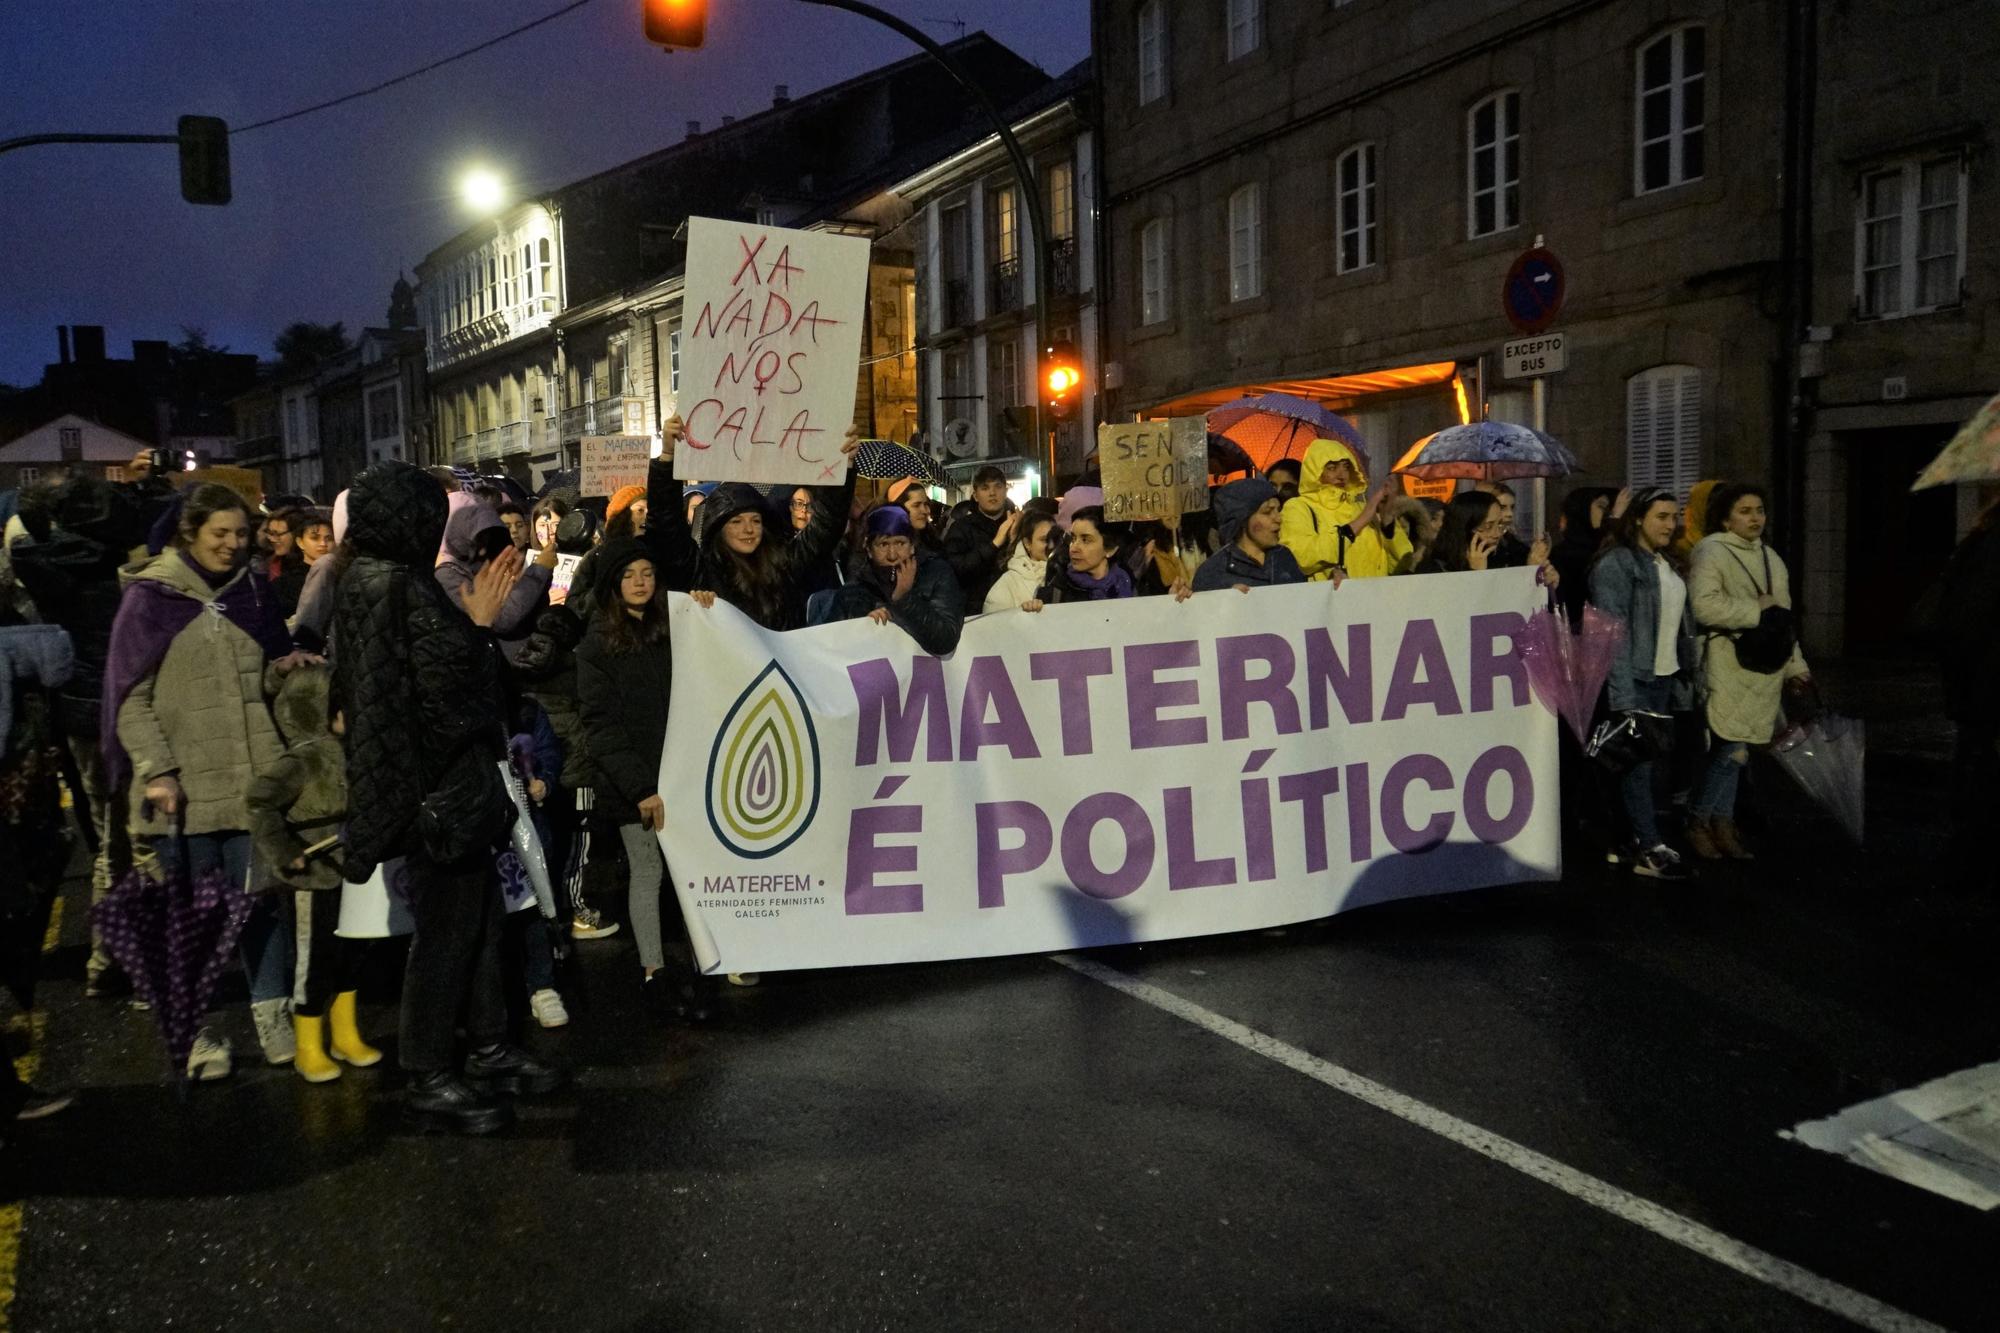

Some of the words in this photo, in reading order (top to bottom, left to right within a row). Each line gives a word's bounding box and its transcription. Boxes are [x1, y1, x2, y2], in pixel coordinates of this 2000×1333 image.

[732, 234, 806, 292] XA
[692, 288, 847, 351] NADA
[1506, 338, 1561, 358] EXCEPTO
[714, 344, 807, 396] NOS
[1521, 357, 1546, 372] BUS
[685, 398, 826, 463] CALA
[586, 442, 598, 451] EL
[1115, 432, 1174, 460] SEN
[847, 611, 1532, 766] MATERNAR
[844, 774, 925, 916] É
[975, 745, 1534, 910] POLÍTICO
[703, 874, 811, 893] MATERFEM
[735, 910, 780, 918] GALEGAS
[769, 897, 825, 906] FEMINISTAS
